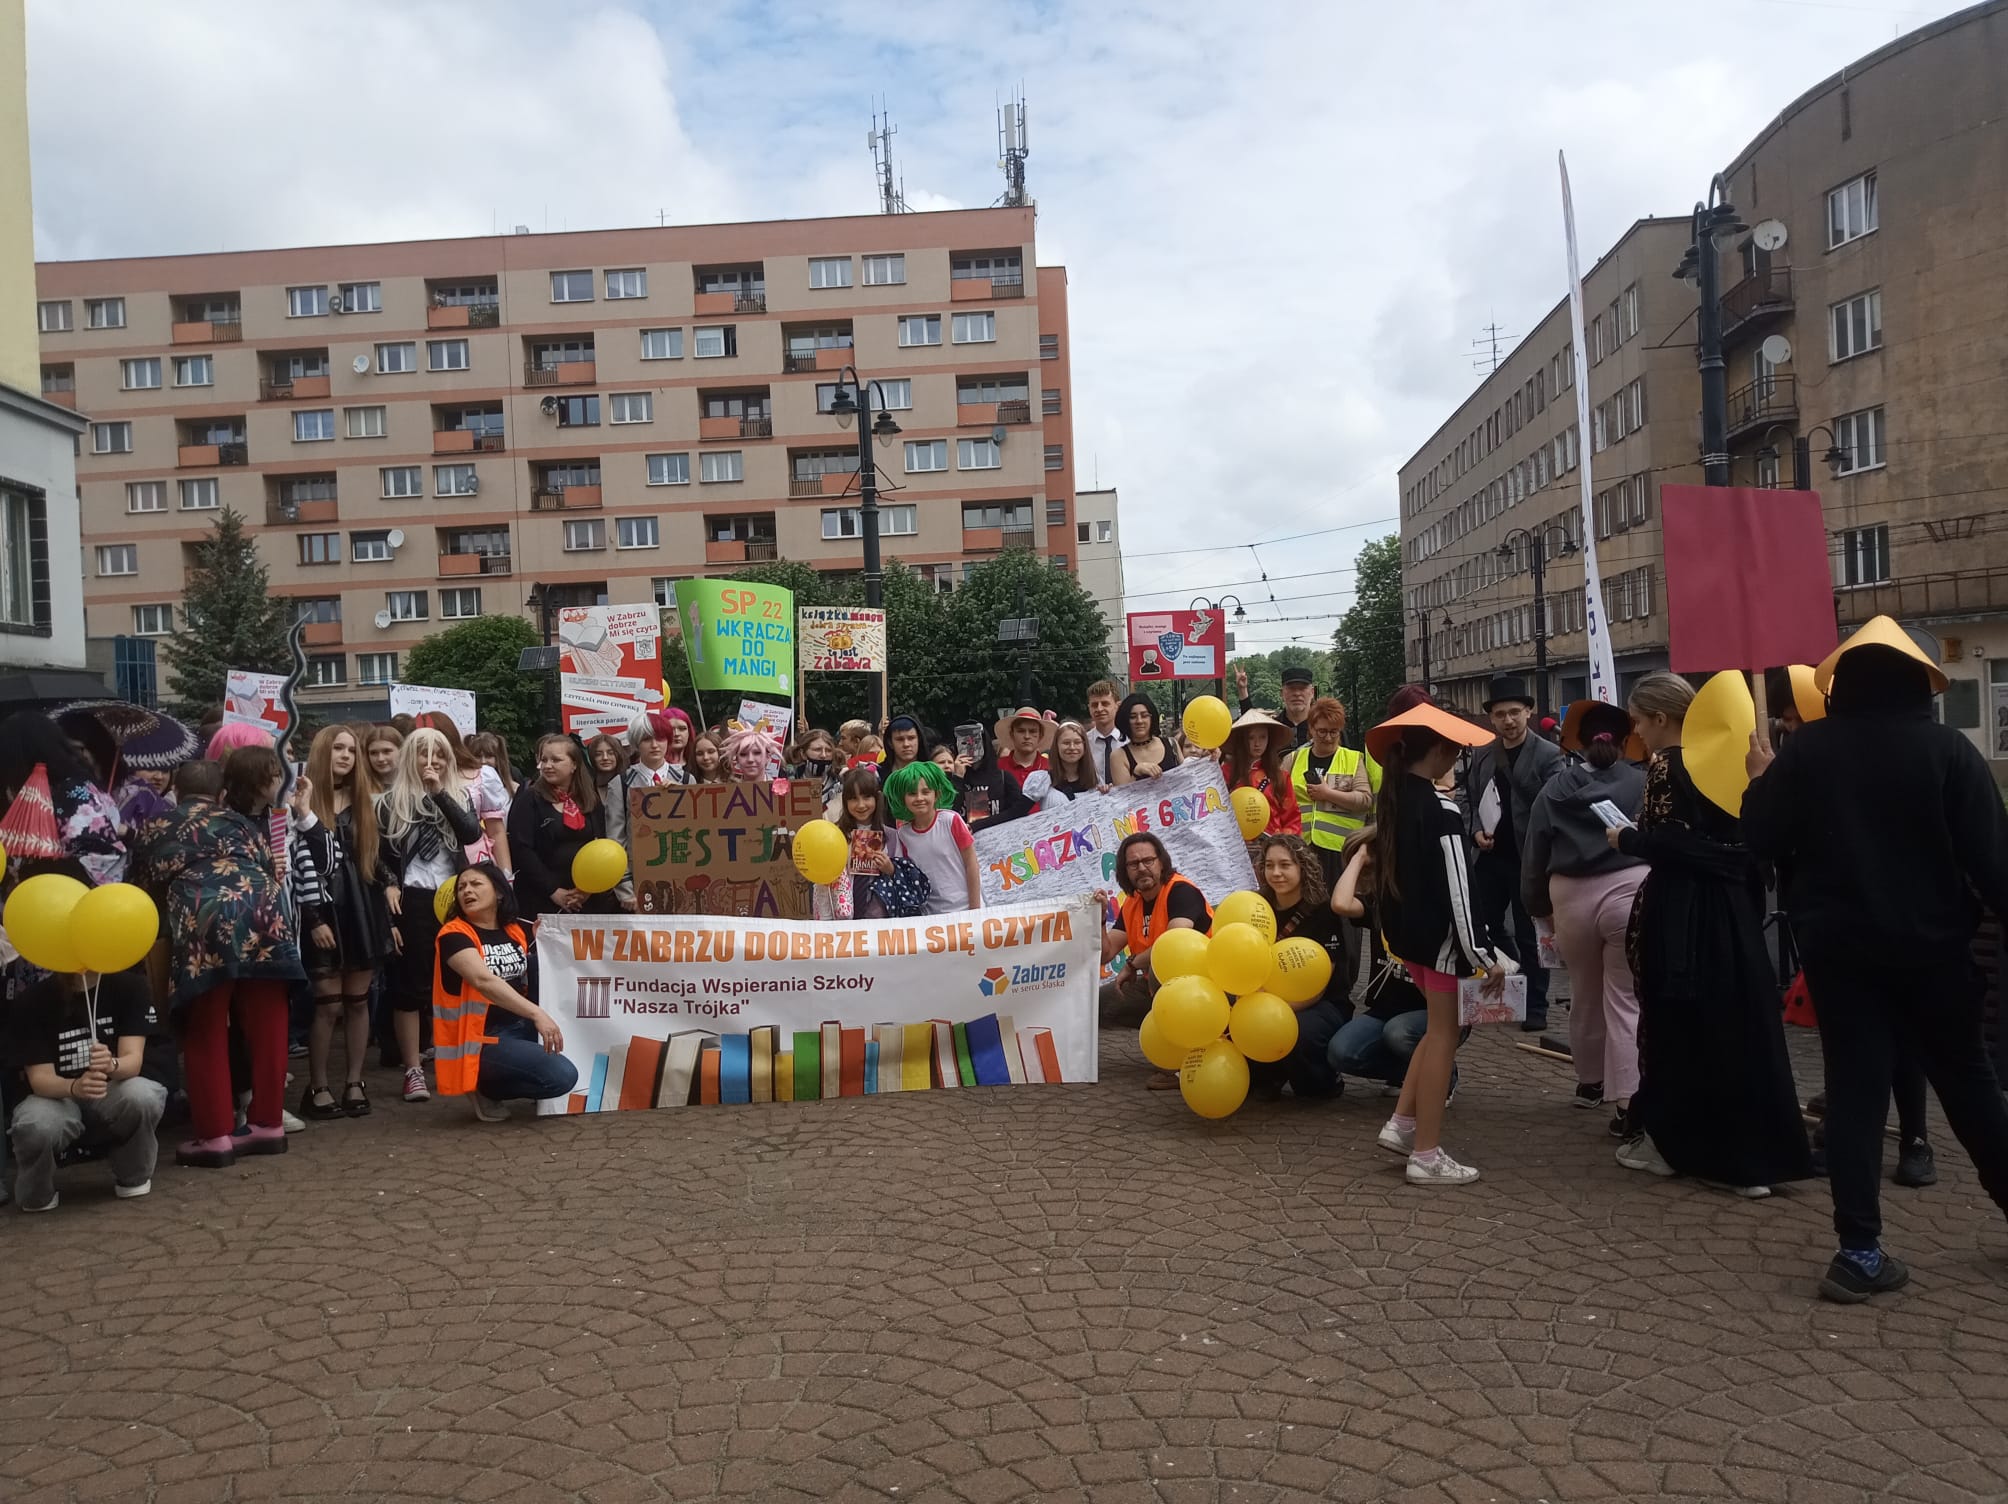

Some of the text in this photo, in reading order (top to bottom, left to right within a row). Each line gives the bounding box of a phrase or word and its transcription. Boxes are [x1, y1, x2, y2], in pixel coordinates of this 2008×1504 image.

[720, 589, 782, 620] SP 22
[606, 611, 646, 623] W Zabrzu
[608, 620, 638, 630] dobrze
[609, 630, 620, 638] Mi
[635, 623, 658, 634] czyta
[717, 619, 792, 643] WKRACZA
[741, 639, 765, 657] DO
[723, 657, 776, 677] MANGI
[814, 655, 871, 670] zabawa
[606, 717, 628, 725] parada
[641, 782, 812, 819] CZYTANIE
[646, 827, 746, 867] JEST
[990, 817, 1102, 890] KSIĄŻKI
[1112, 807, 1150, 841] NIE
[1158, 786, 1228, 827] GRYZĄ
[571, 911, 1073, 963] W ZABRZU DOBRZE MI SIĘ CZYTA
[1011, 963, 1066, 985] Zabrze
[614, 974, 874, 997] Fundacja Wspierania Szkoły
[1020, 984, 1040, 993] sercu
[1042, 979, 1065, 989] Śląska
[613, 998, 750, 1018] "Nasza Trójka"
